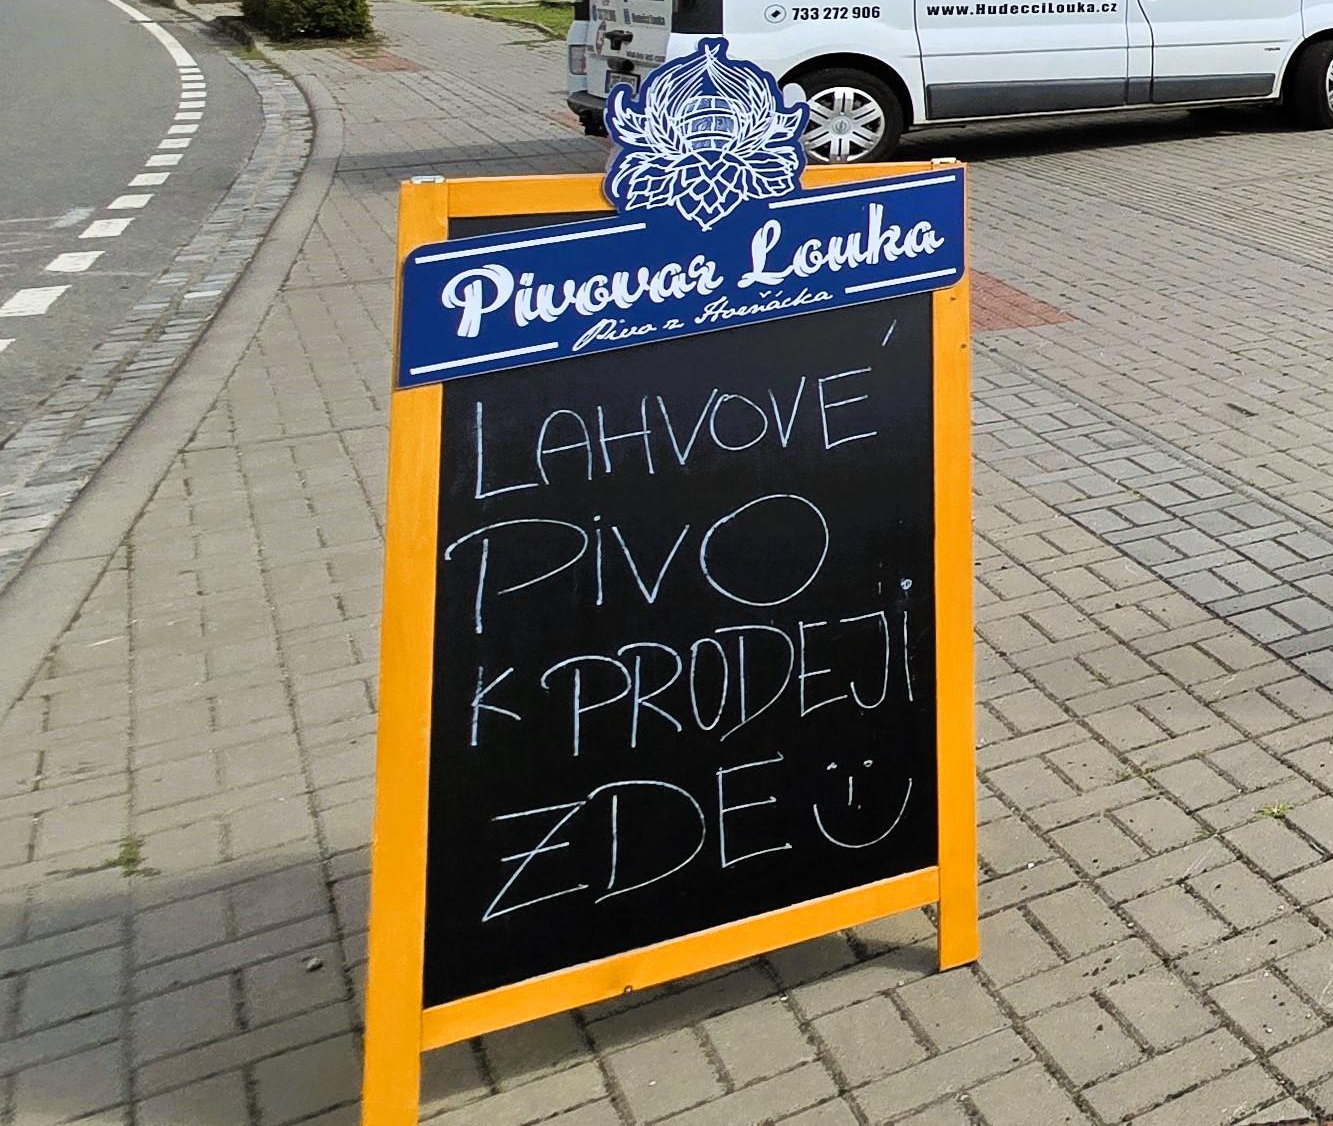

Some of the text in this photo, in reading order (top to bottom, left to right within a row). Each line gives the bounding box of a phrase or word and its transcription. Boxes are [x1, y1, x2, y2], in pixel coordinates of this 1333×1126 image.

[792, 6, 881, 21] 733 272 906
[926, 1, 1118, 16] www.HudecciLouka.cz
[441, 202, 945, 339] Pivovar Louka
[571, 288, 834, 352] Pivo z Horňácka
[474, 318, 897, 500] LAHVOVÉ
[481, 751, 793, 923] ZDE
